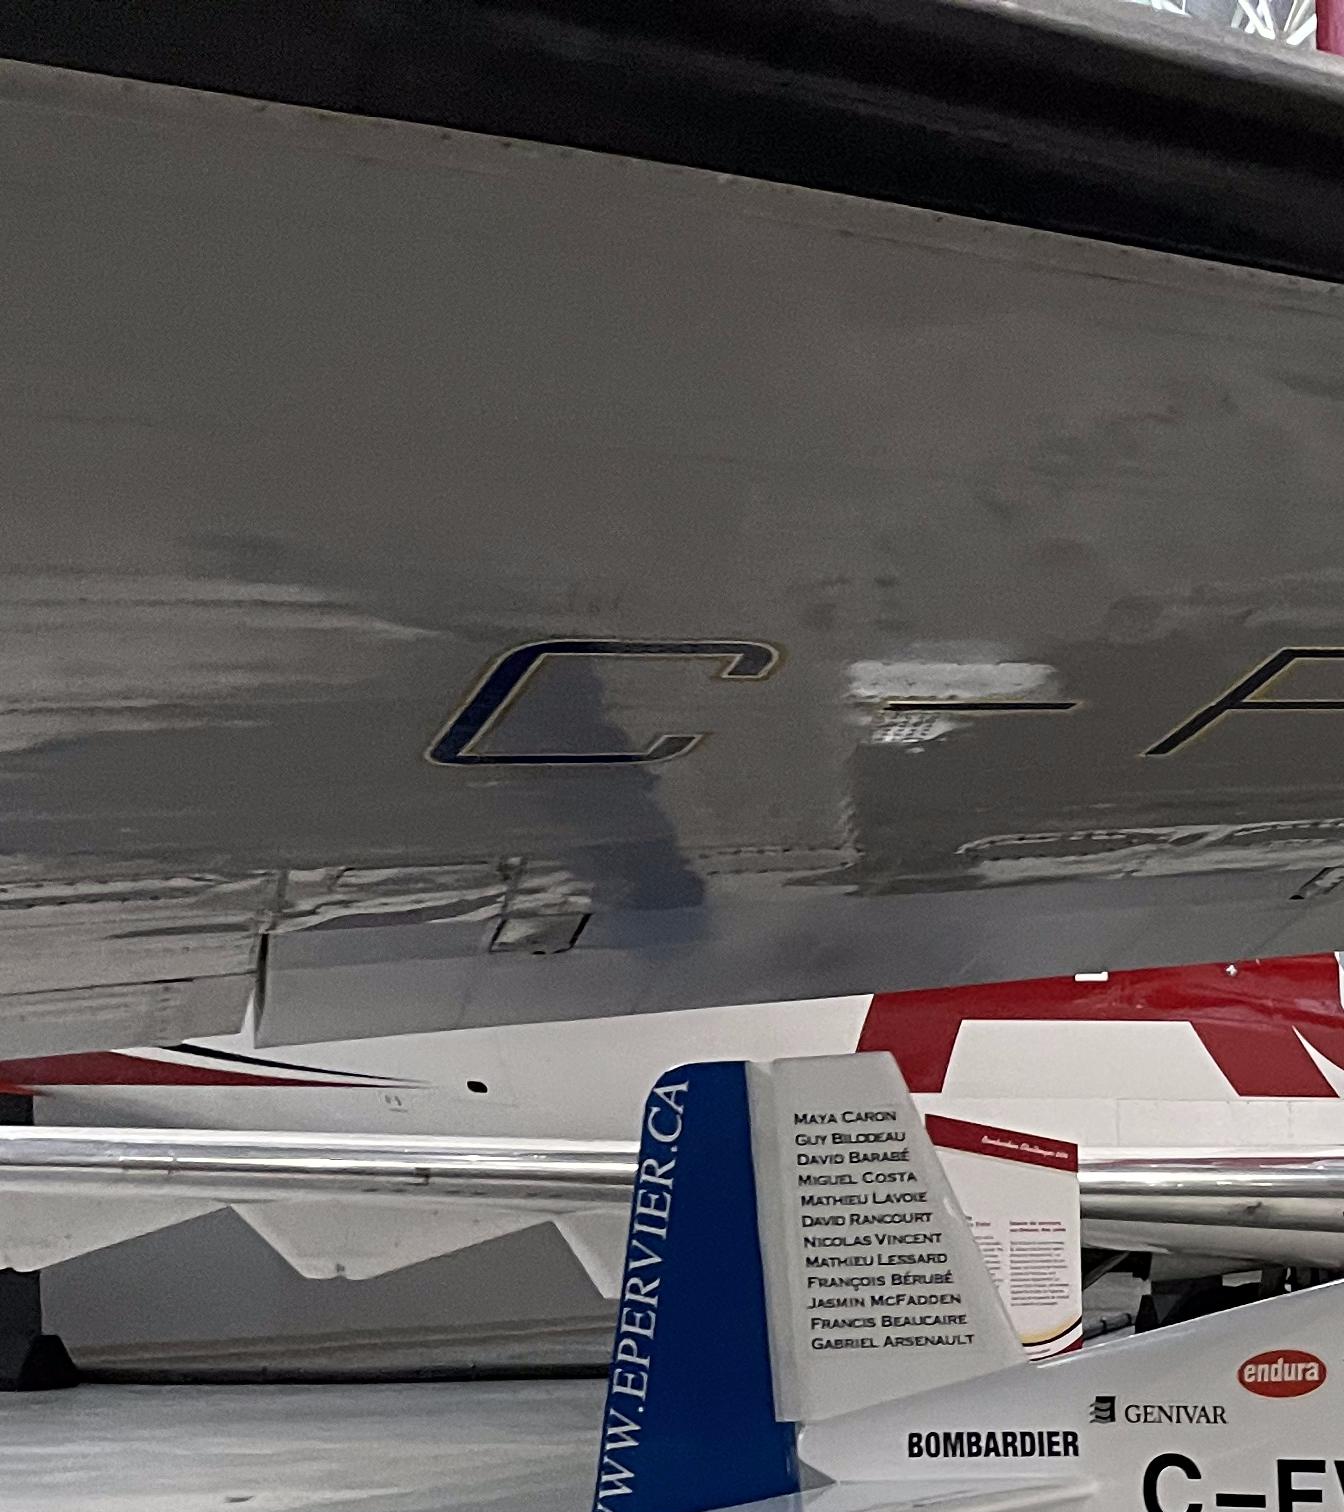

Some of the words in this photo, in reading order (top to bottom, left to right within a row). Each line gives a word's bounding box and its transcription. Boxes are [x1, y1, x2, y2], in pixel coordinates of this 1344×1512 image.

[1244, 1358, 1320, 1382] endura
[1124, 1405, 1227, 1424] GENIVAR
[907, 1431, 1080, 1458] BOMBARDIER
